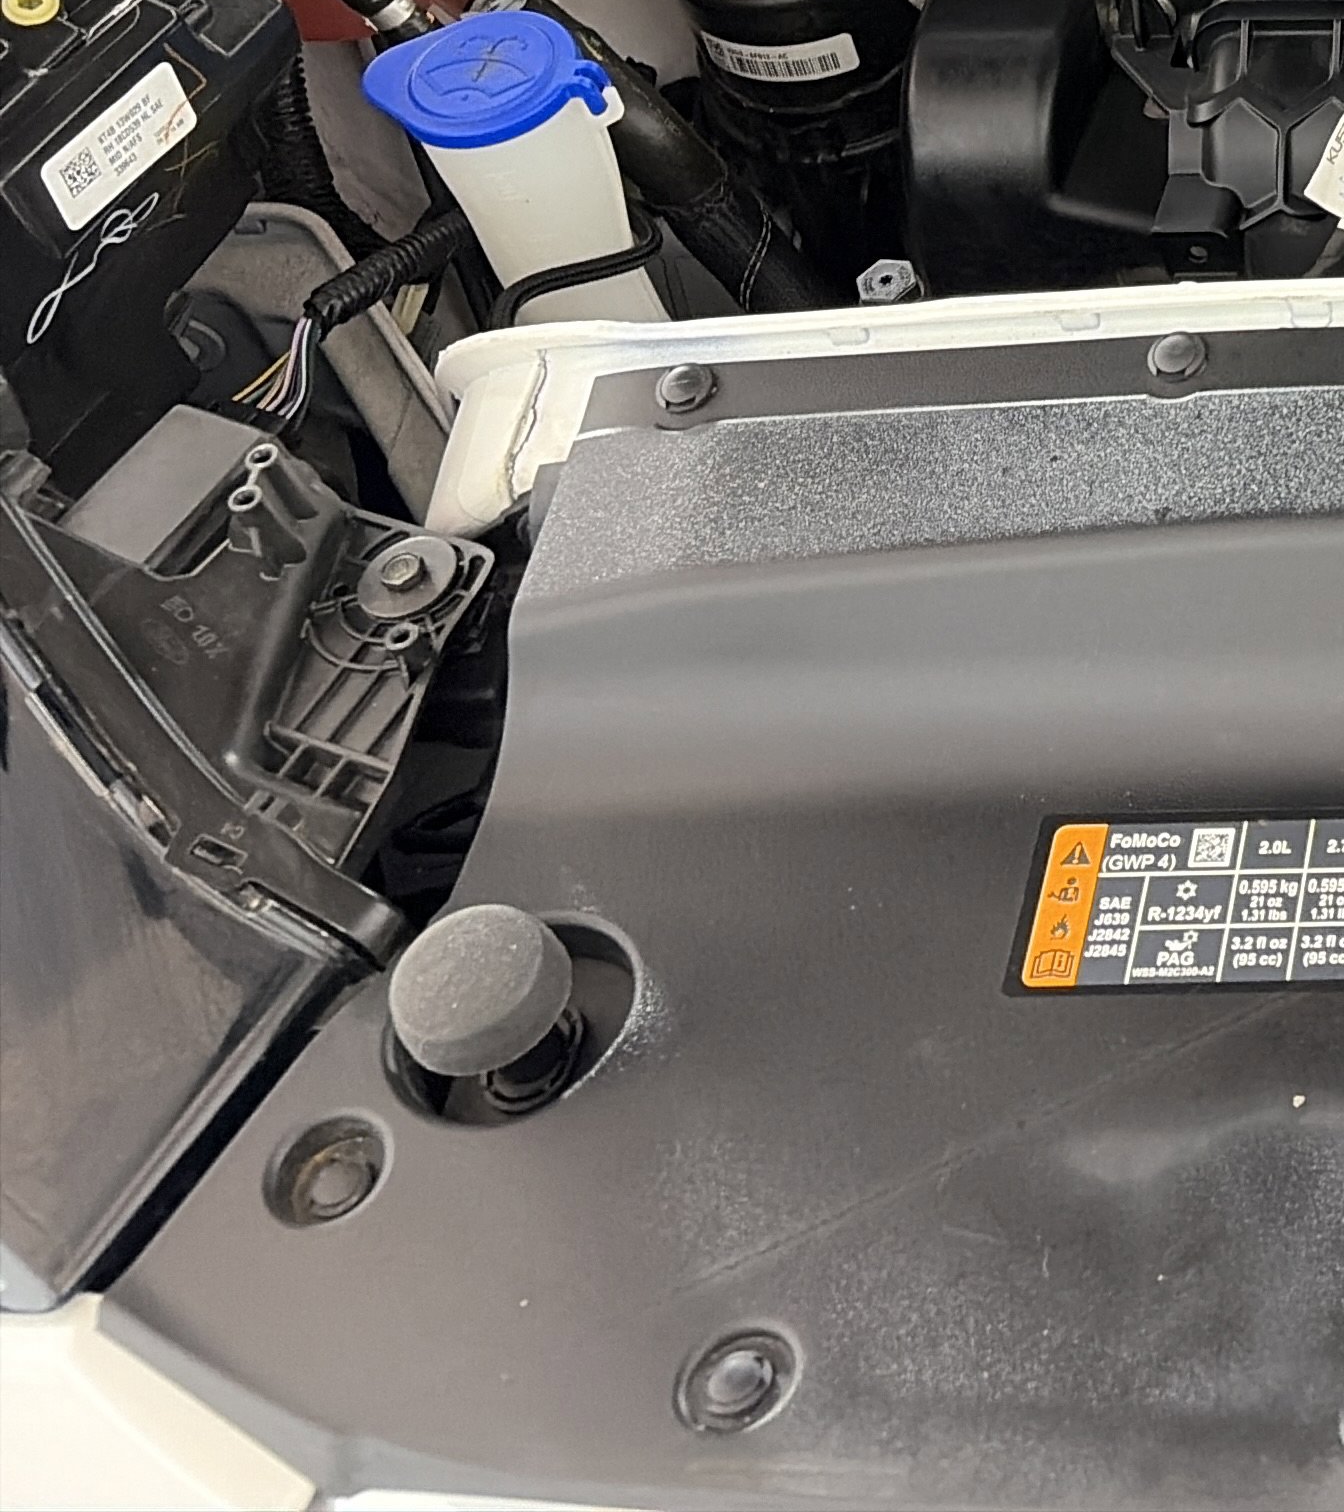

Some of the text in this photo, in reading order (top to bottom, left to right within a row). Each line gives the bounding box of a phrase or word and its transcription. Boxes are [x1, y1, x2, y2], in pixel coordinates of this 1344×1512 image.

[103, 98, 164, 155] RH HL SAE
[98, 125, 116, 144] KT4B
[109, 150, 124, 165] MID
[1110, 833, 1181, 848] FoMoCo
[1258, 841, 1291, 854] 2.0L
[1102, 854, 1176, 872] (GWP 4)
[1239, 879, 1298, 897] 0.595 kg
[1099, 897, 1132, 910] SAE
[1250, 896, 1282, 907] 21 oz
[1319, 895, 1333, 906] 21
[1094, 913, 1130, 926] J639
[1147, 905, 1222, 923] R-1234yf
[1241, 908, 1287, 921] 1.31 lbs
[1310, 907, 1334, 920] 1.31
[1088, 929, 1130, 941] J2842
[1301, 935, 1323, 949] 3.2
[1326, 935, 1336, 948] fl
[1231, 936, 1287, 950] 3.2 fl oz
[1084, 944, 1127, 957] J2845
[1156, 952, 1195, 966] PAG
[1233, 952, 1282, 968] (95 cc)
[1303, 952, 1326, 968] (95
